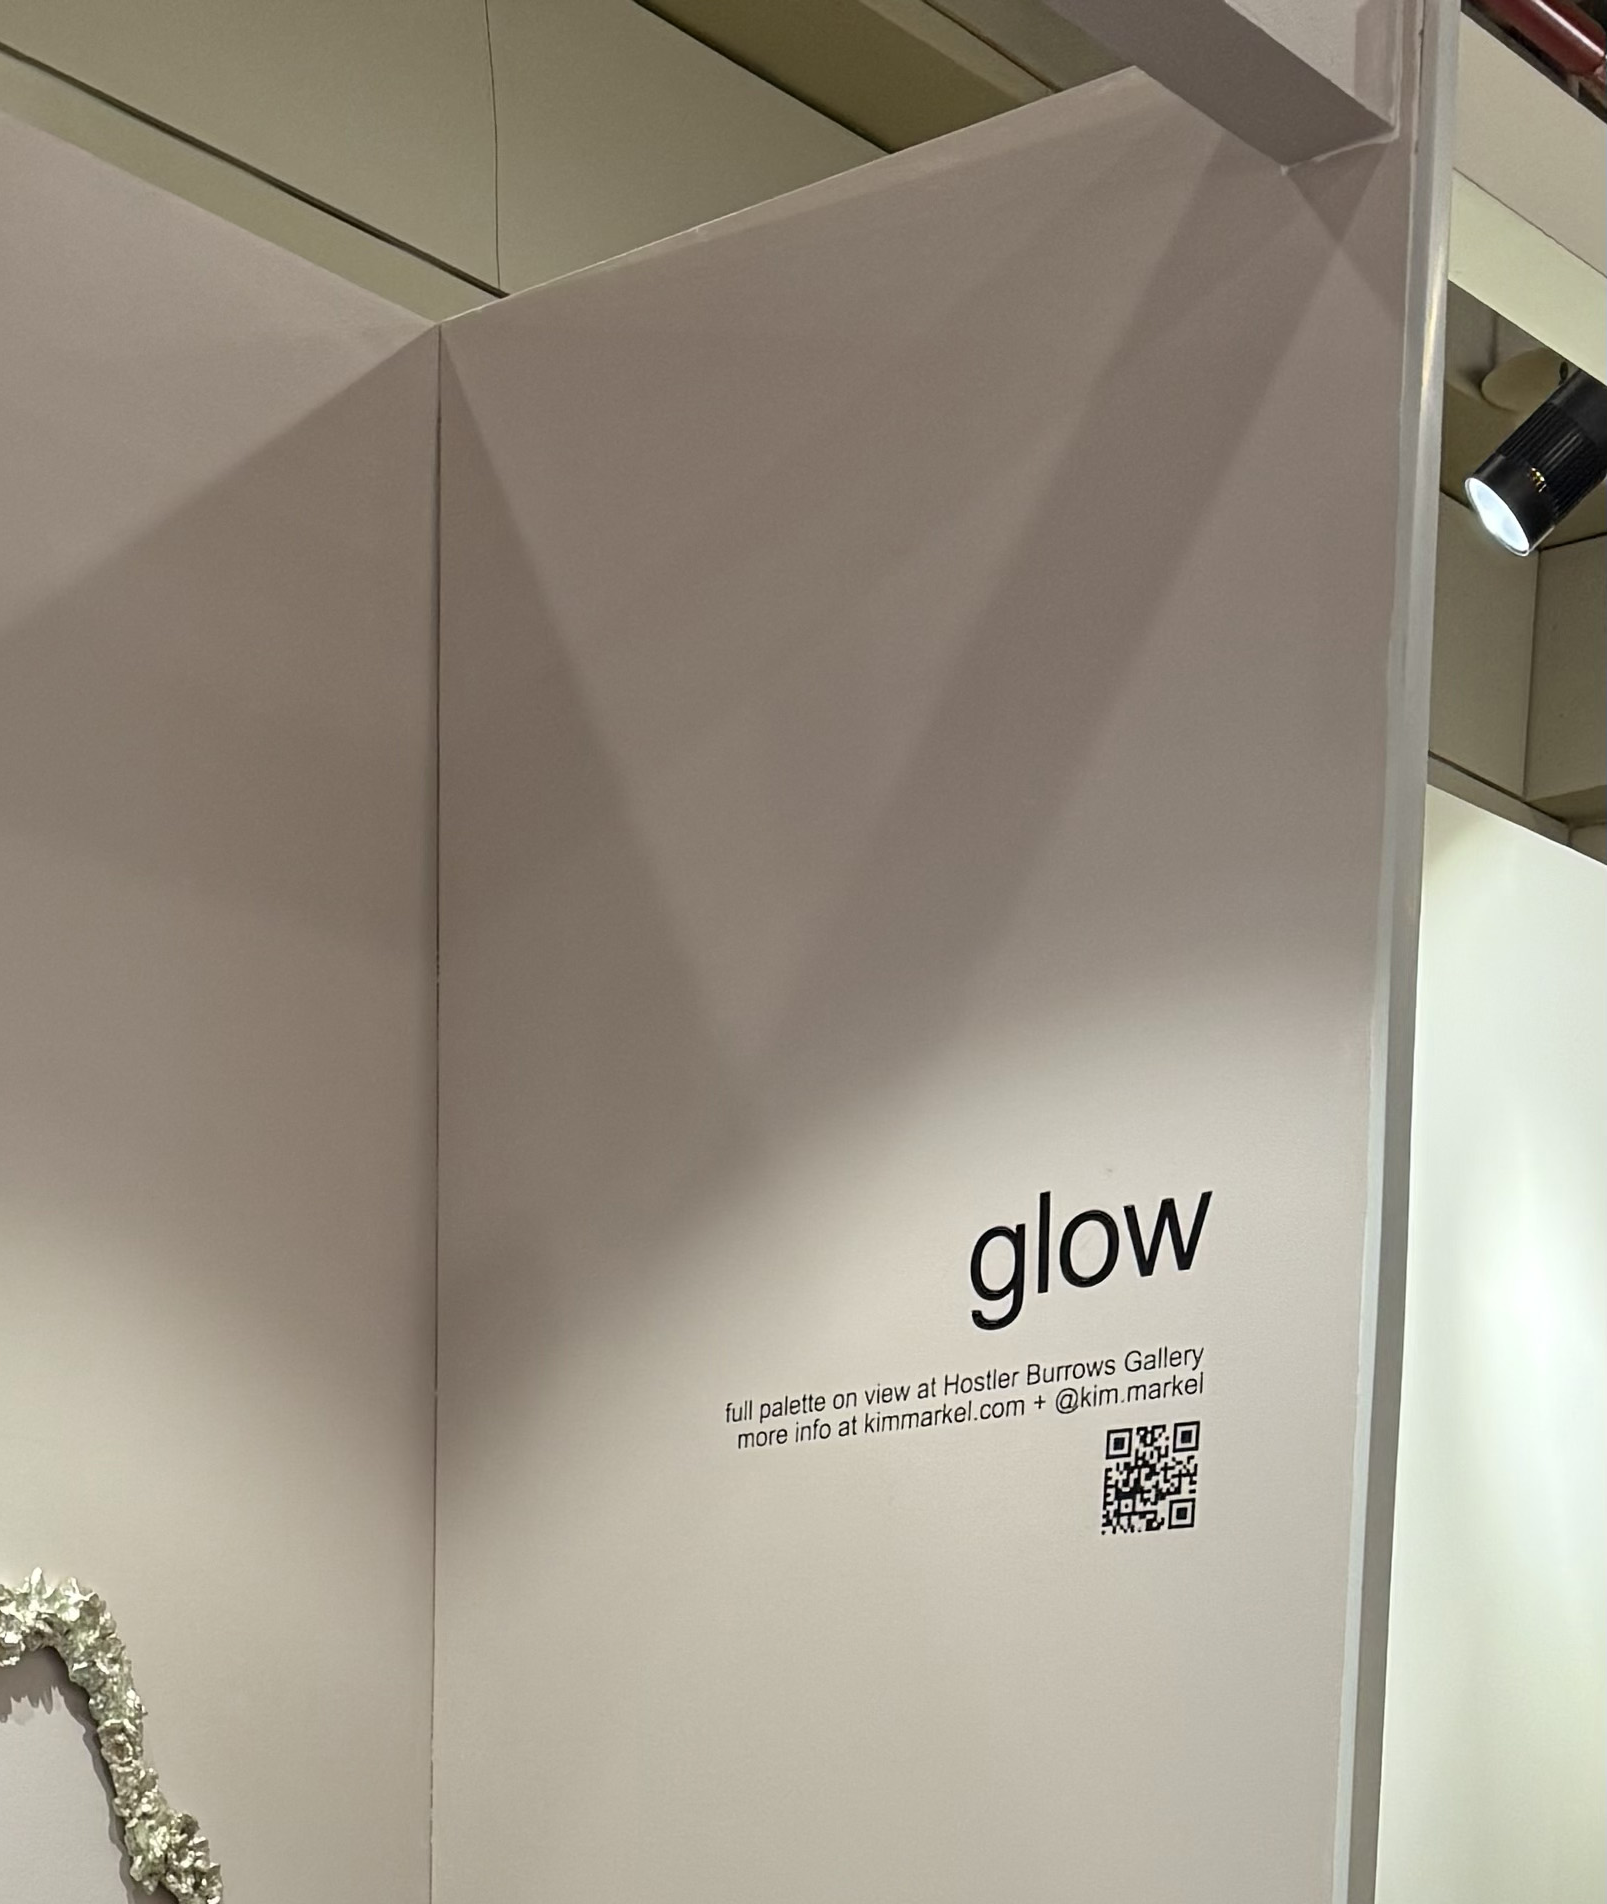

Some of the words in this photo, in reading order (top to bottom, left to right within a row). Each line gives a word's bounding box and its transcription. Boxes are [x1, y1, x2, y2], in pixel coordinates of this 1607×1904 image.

[969, 1190, 1213, 1331] glow
[725, 1400, 753, 1423] full
[759, 1393, 826, 1424] palette
[832, 1391, 858, 1410] on
[864, 1384, 911, 1406] view
[917, 1376, 937, 1400] at
[944, 1368, 1020, 1396] Hostler
[1026, 1358, 1116, 1386] Burrows
[1124, 1345, 1205, 1373] Gallery
[737, 1428, 788, 1450] more
[795, 1418, 832, 1443] info
[838, 1415, 858, 1438] at
[864, 1399, 1025, 1434] kimmarkel.com
[1033, 1394, 1047, 1410] +
[1055, 1371, 1204, 1415] @kim.markel
